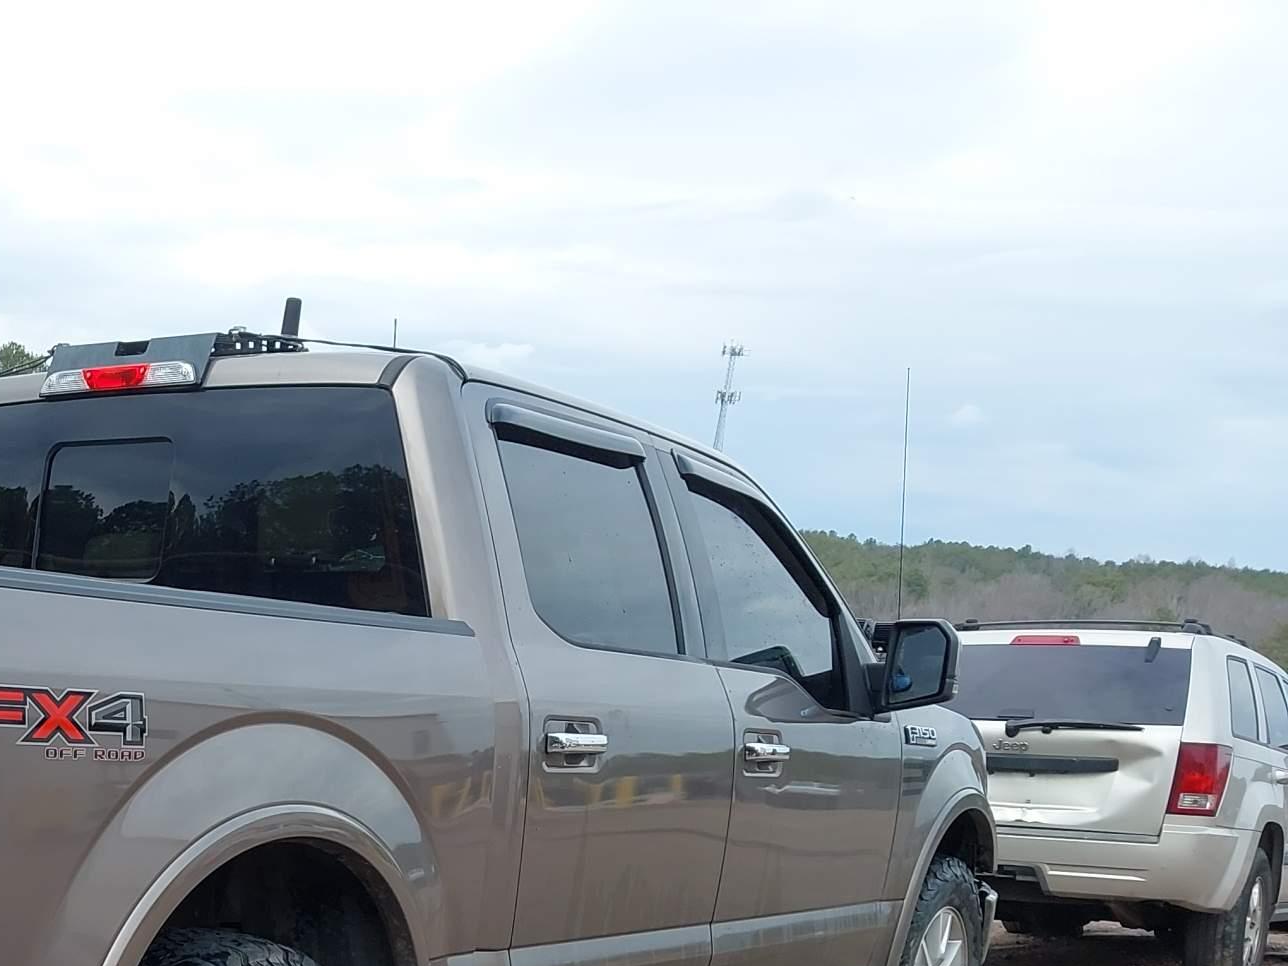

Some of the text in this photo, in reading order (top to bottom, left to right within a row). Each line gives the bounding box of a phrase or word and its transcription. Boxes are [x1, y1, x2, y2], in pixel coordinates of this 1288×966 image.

[992, 738, 1029, 752] Jeep
[45, 747, 145, 762] OFF ROAD
